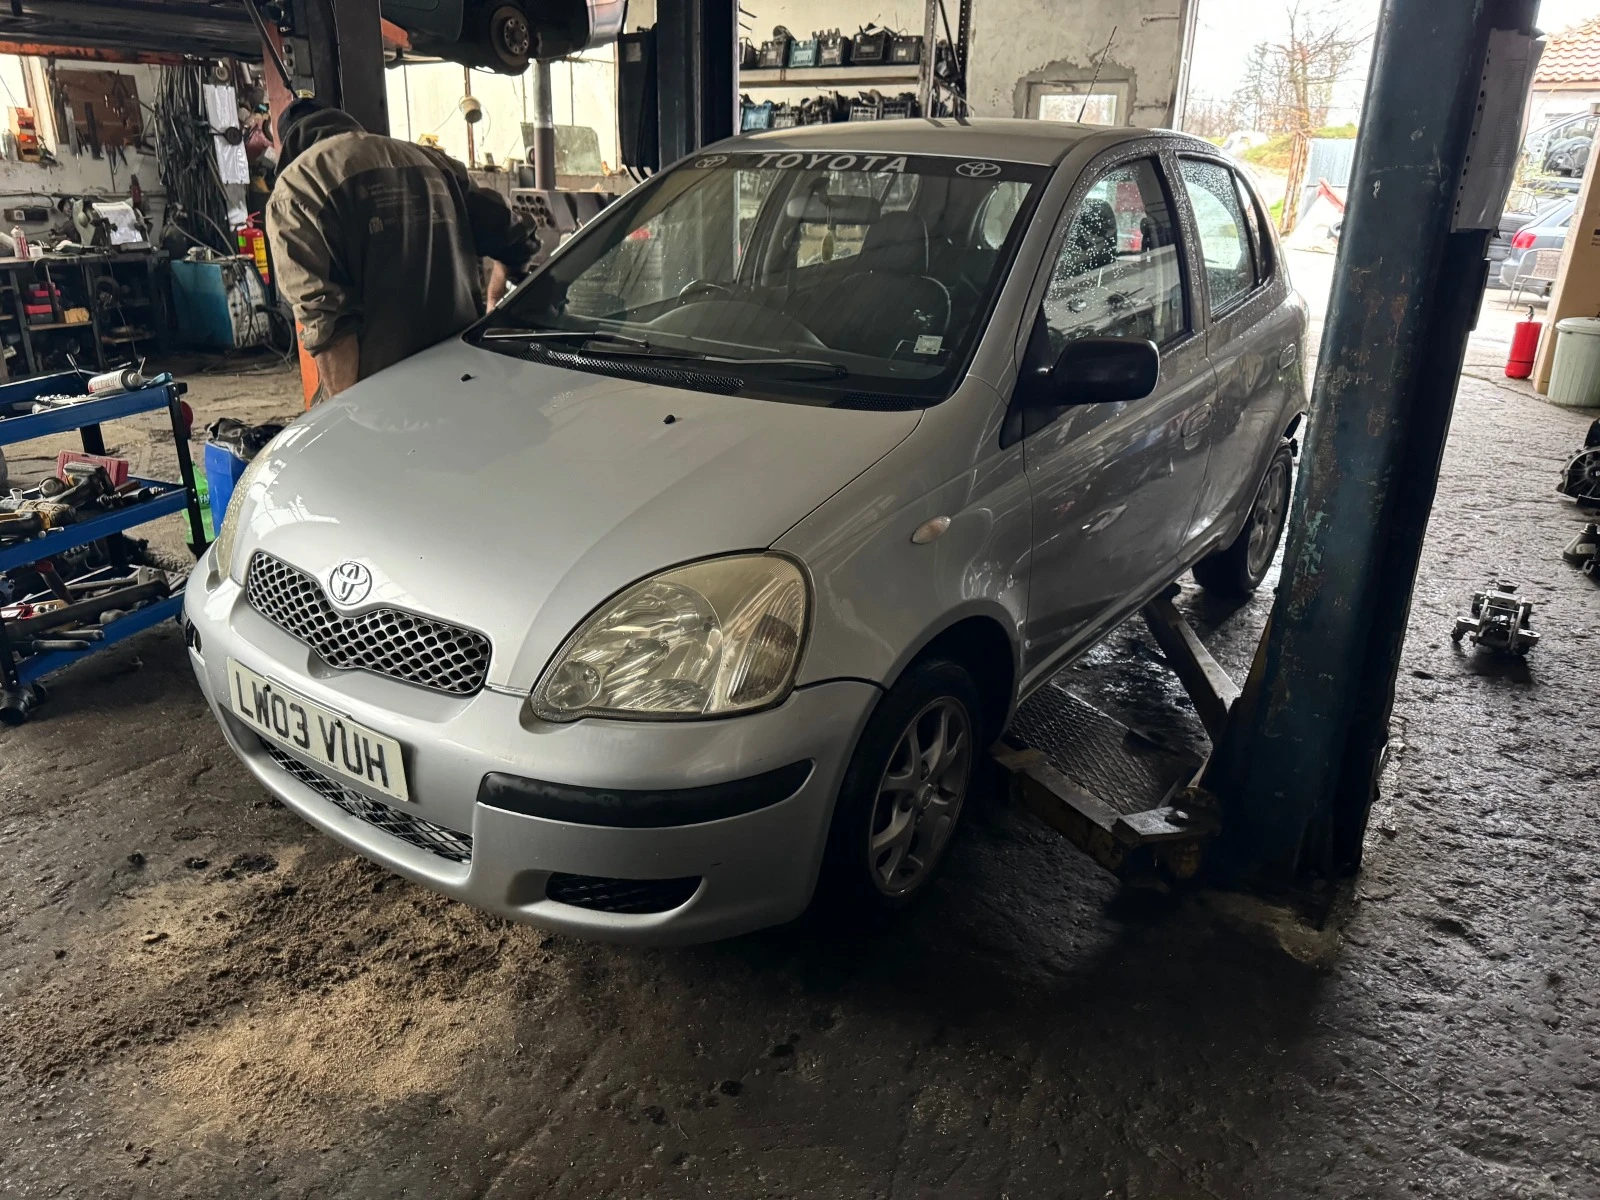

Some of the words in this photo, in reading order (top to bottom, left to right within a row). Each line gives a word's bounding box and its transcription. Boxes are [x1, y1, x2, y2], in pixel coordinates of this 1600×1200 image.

[756, 153, 908, 173] TOYOTA
[235, 670, 311, 750] LW03
[317, 714, 389, 789] VUH
